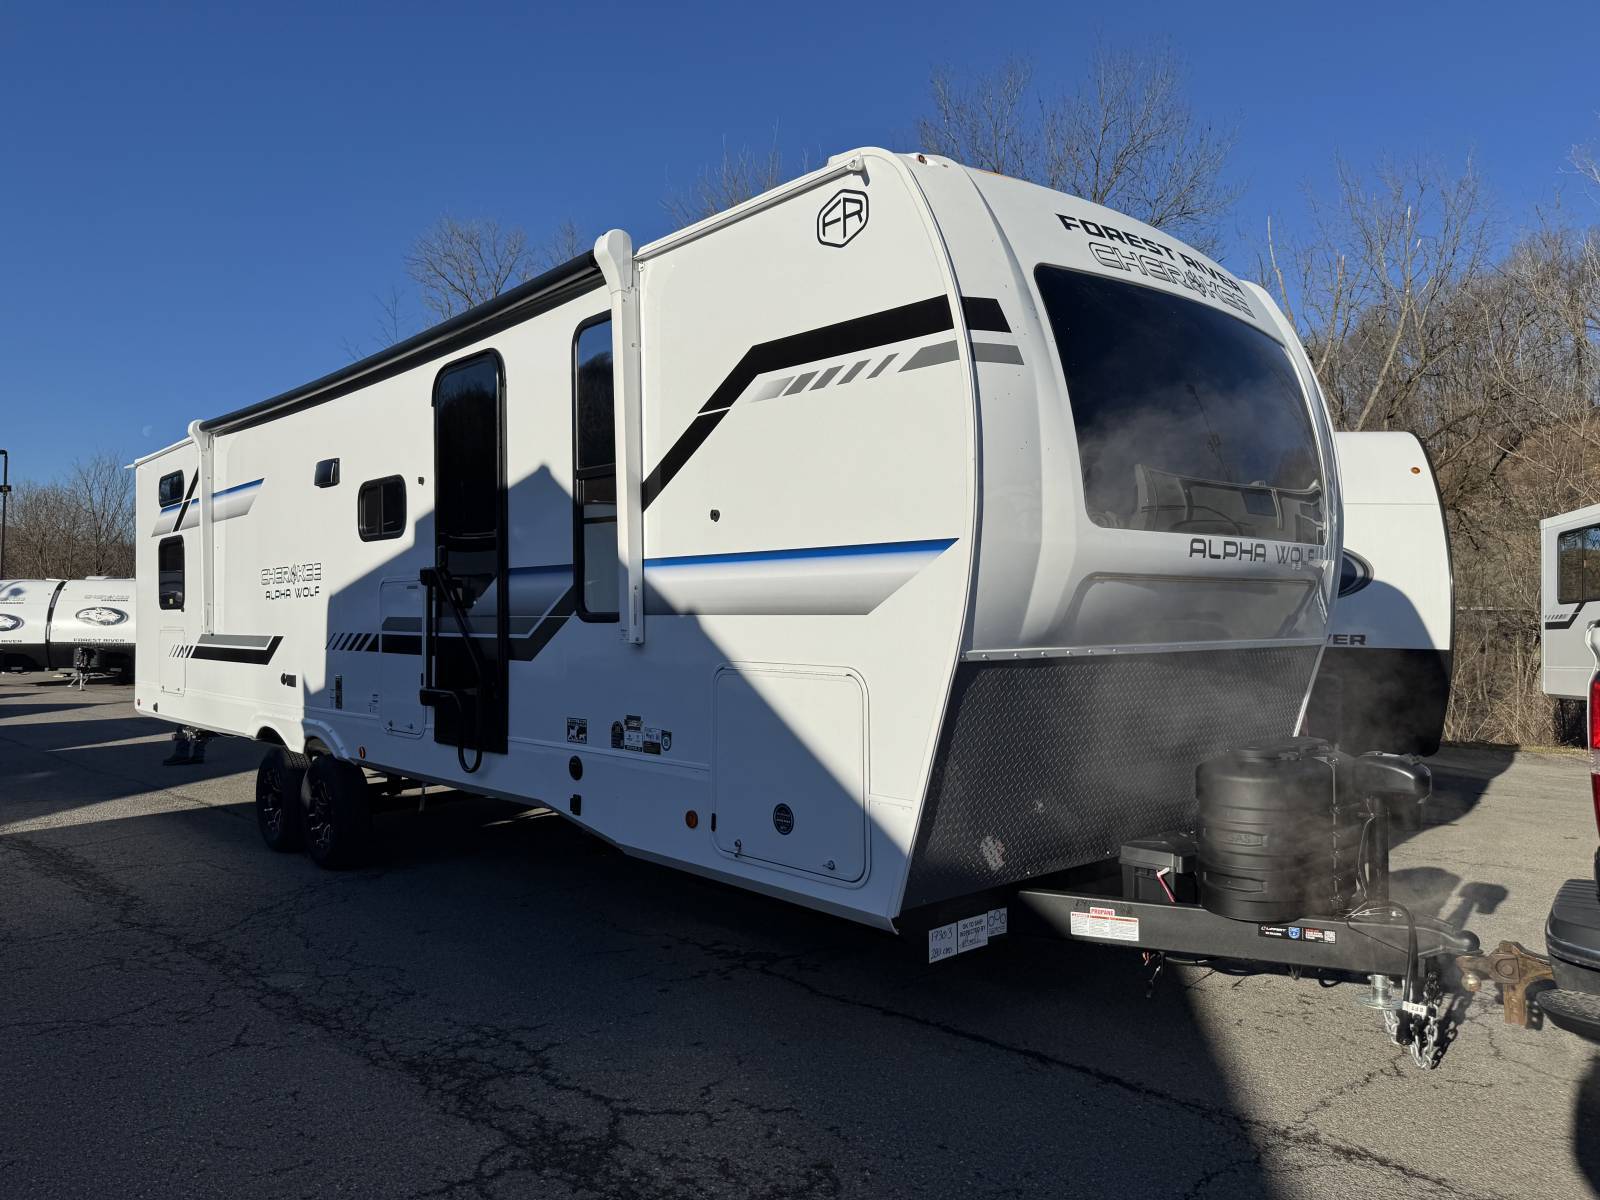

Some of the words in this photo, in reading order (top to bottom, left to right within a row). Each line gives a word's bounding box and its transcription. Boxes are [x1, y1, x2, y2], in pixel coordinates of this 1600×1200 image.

[1055, 213, 1176, 261] FOREST
[1178, 252, 1246, 297] RIVER
[1189, 537, 1267, 563] ALPHA
[1275, 544, 1316, 565] WOLF
[265, 588, 291, 601] ALPHA
[294, 585, 320, 599] WOLF
[1090, 908, 1114, 916] PROPANE
